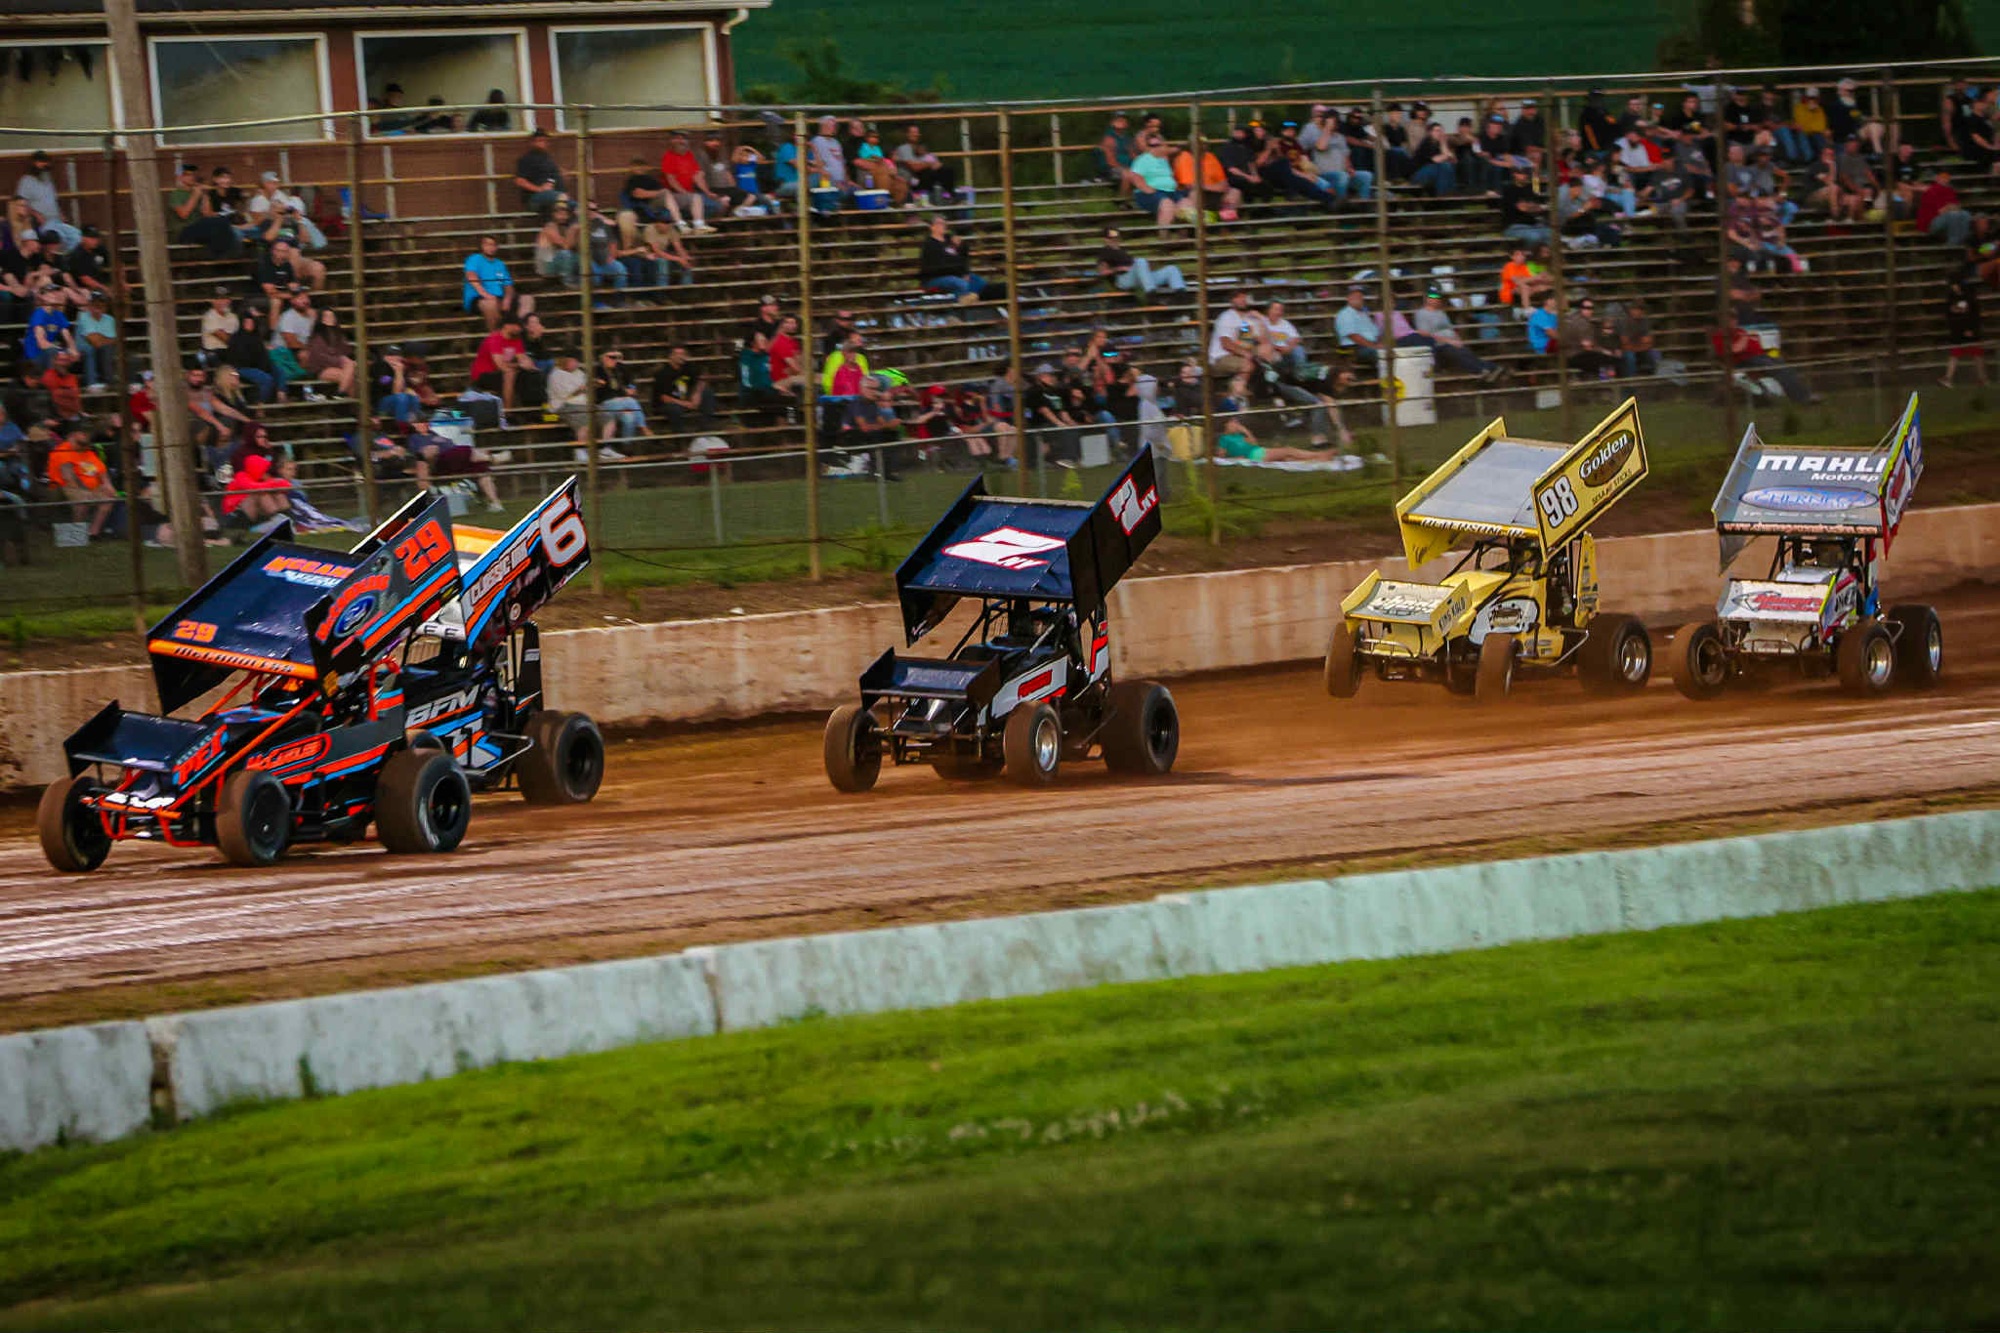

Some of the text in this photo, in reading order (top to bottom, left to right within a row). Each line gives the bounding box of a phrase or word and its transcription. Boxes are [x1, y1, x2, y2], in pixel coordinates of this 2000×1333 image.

[1580, 433, 1628, 478] Golden
[1539, 475, 1579, 528] 98
[394, 519, 452, 582] 29
[539, 493, 588, 568] 6
[173, 619, 219, 644] 29
[405, 684, 480, 729] BFM
